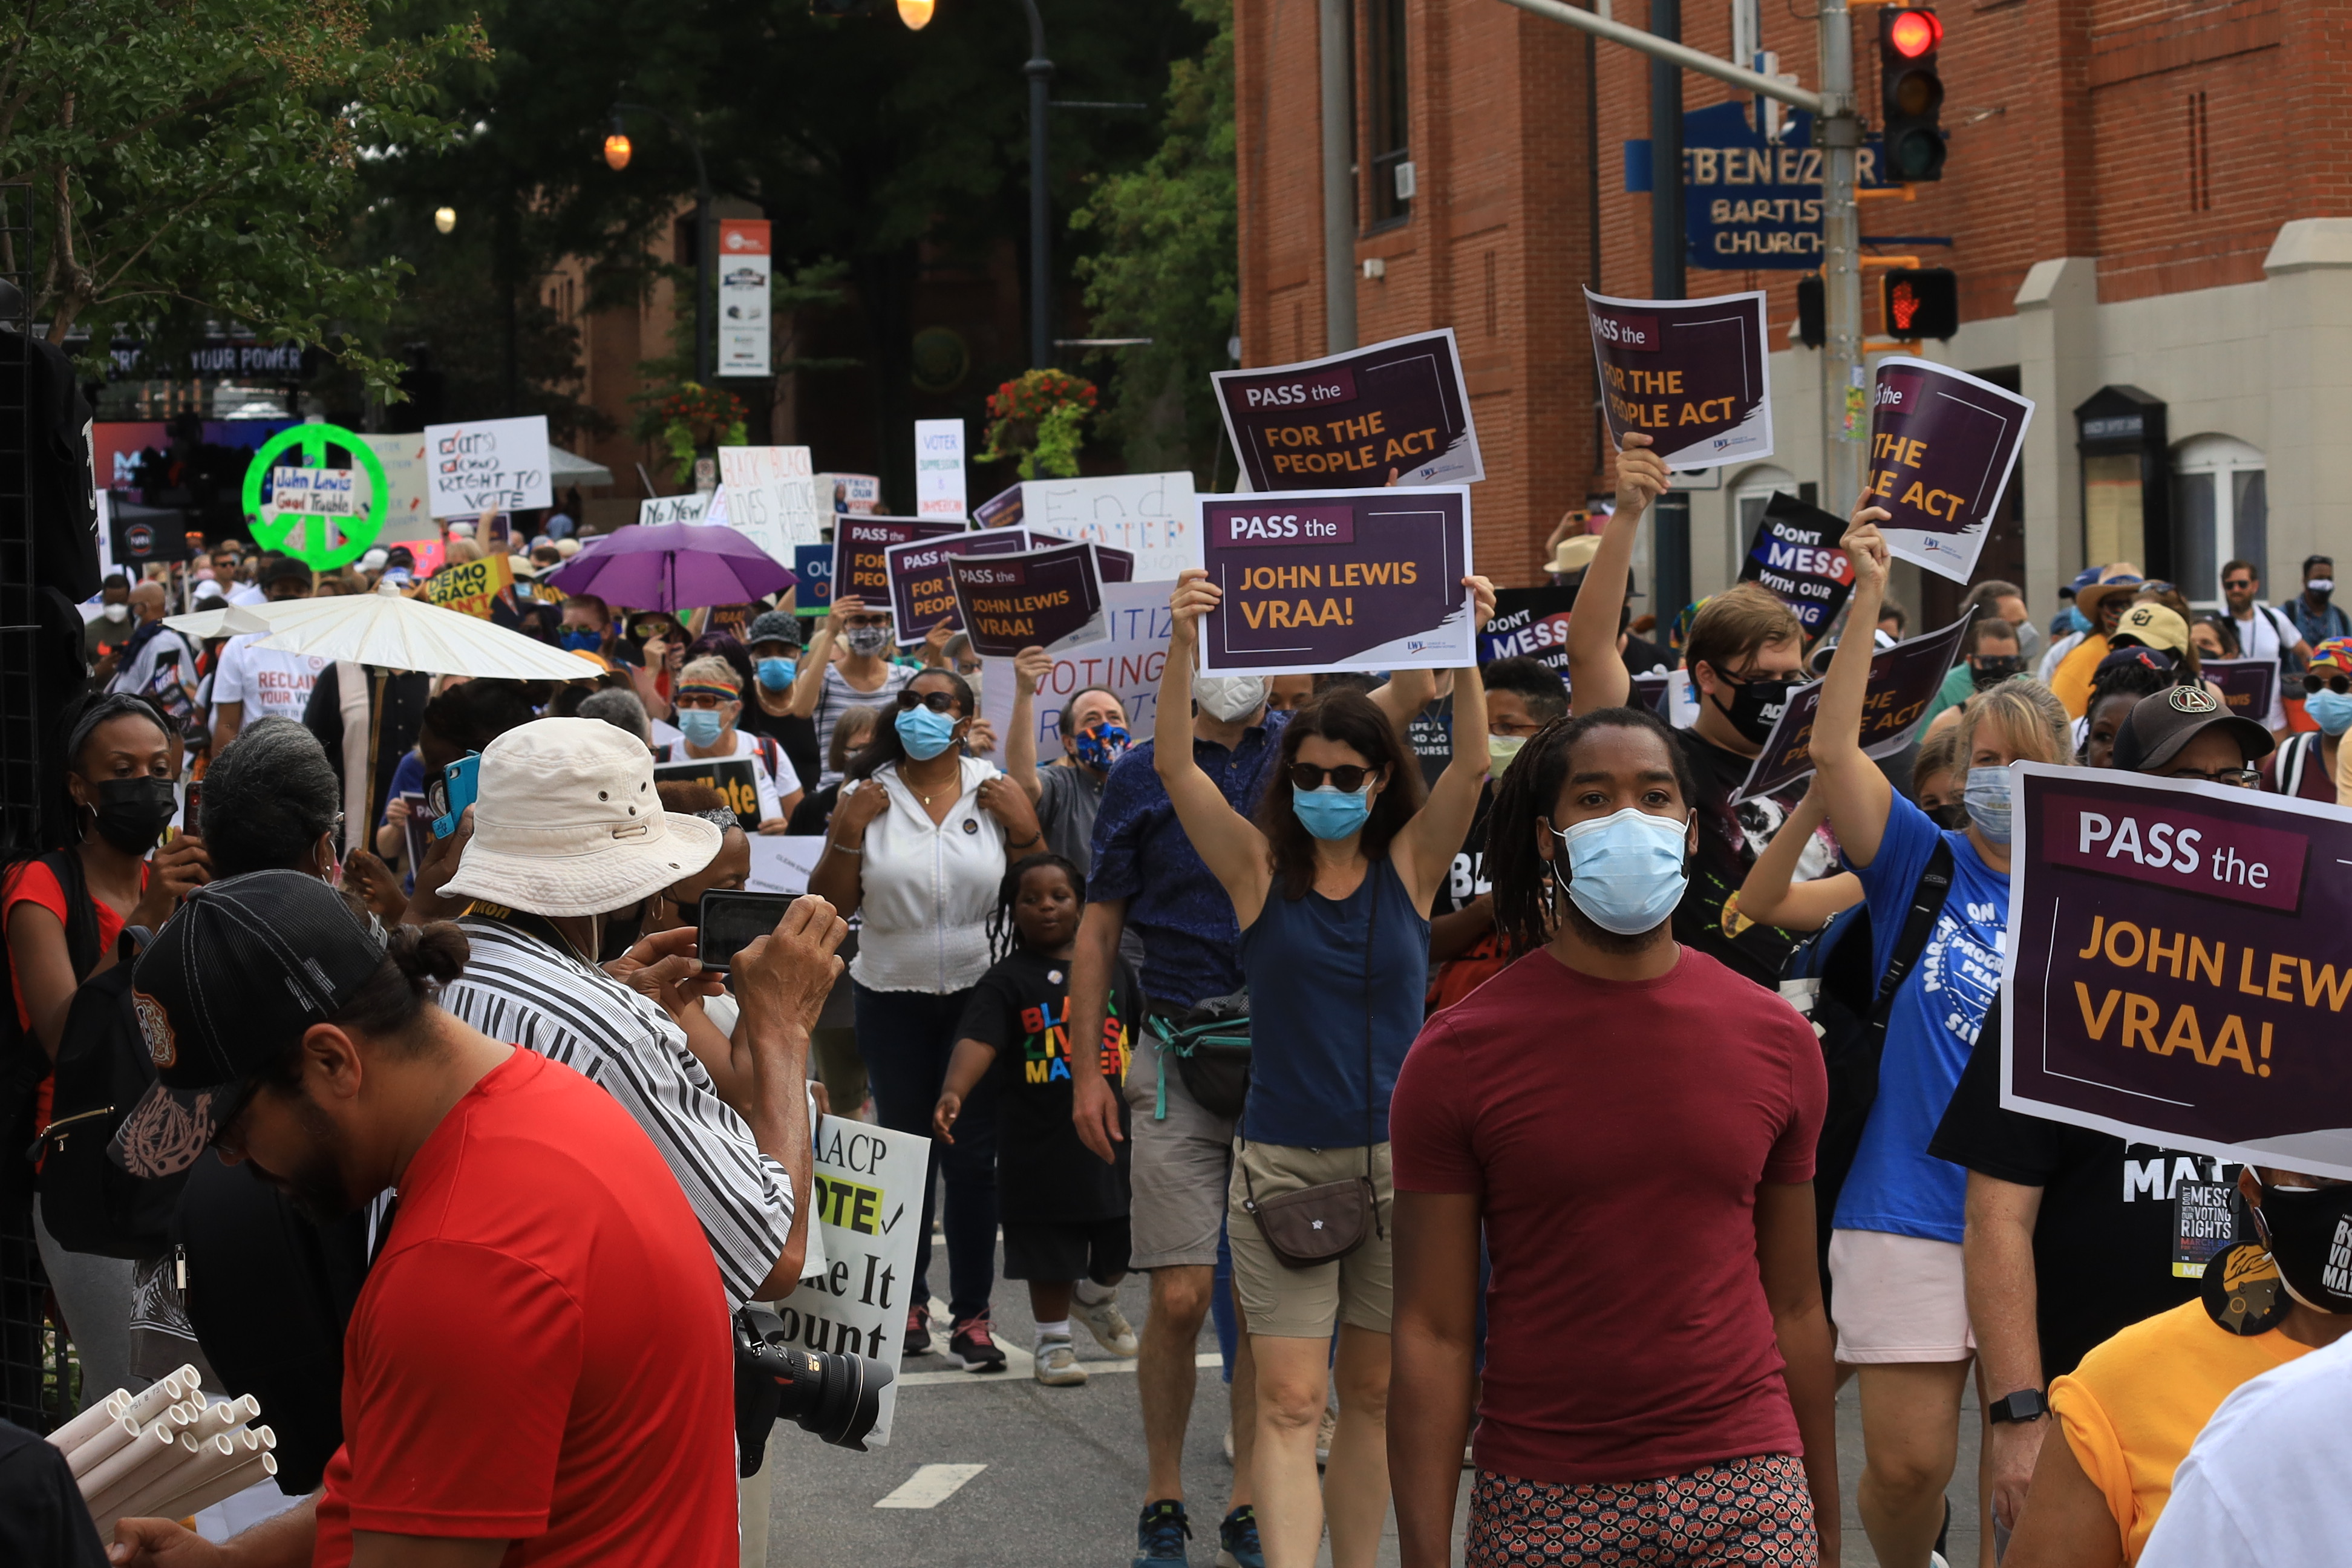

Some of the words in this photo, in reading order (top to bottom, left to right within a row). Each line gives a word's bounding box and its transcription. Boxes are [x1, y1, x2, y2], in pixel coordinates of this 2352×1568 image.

[1683, 148, 1877, 185] BENEZR
[1592, 313, 1618, 341] PASS
[1621, 326, 1645, 344] the
[241, 347, 301, 370] POWER
[1604, 361, 1626, 391] FOR
[1629, 370, 1684, 394] THE
[1246, 384, 1307, 407] PASS
[1311, 384, 1341, 400] the
[1881, 385, 1903, 405] the
[1609, 393, 1670, 427] PEOPLE
[1678, 396, 1735, 426] ACT
[1264, 425, 1323, 448] FOR
[1327, 411, 1385, 443] THE
[923, 434, 958, 451] VOTER
[1273, 445, 1377, 474] PEOPLE
[1384, 428, 1438, 462] ACT
[1875, 433, 1928, 469] THE
[276, 469, 309, 489] John
[439, 472, 505, 492] RIGHT
[514, 469, 541, 490] TO
[276, 492, 305, 509] Good
[310, 492, 349, 512] Trouble
[464, 489, 524, 509] VOTE
[1046, 475, 1172, 523] End
[1900, 481, 1965, 522] ACT
[646, 501, 664, 525] No
[852, 527, 888, 541] PASS
[889, 532, 906, 542] the
[1230, 514, 1299, 540] PASS
[1304, 518, 1337, 537] the
[1772, 523, 1822, 546] DON'T
[903, 551, 938, 570] PASS
[1768, 542, 1847, 579] MESS
[429, 563, 486, 592] DEMO
[853, 572, 889, 587] PEO
[912, 578, 944, 597] FOR
[958, 569, 994, 584] PASS
[996, 571, 1016, 583] the
[1240, 565, 1321, 590] JOHN
[1329, 561, 1417, 587] LEWIS
[1759, 569, 1795, 593] WITH
[1799, 583, 1832, 599] OUR
[443, 593, 490, 613] AN'T
[913, 595, 959, 617] PEOP
[972, 598, 1012, 613] JOHN
[1014, 590, 1070, 613] LEWIS
[1240, 597, 1354, 629] VRAA!
[976, 617, 1035, 636] VRAA!
[1487, 609, 1531, 633] DON'T
[1492, 619, 1569, 659] MESS
[260, 690, 290, 705] YOUR
[1864, 690, 1897, 708] HE
[1875, 699, 1925, 731] ACT
[416, 805, 436, 818] PA
[2079, 811, 2203, 875] PASS
[2211, 846, 2270, 889] the
[471, 900, 512, 920] ikon
[1967, 902, 1996, 922] ON
[1923, 915, 1959, 993] MARCH
[1950, 937, 2005, 973] PROGR
[2078, 915, 2226, 987] JOHN
[2238, 947, 2352, 1013] LEW
[1962, 959, 2001, 992] PEAC
[1024, 1017, 1120, 1058] LIVS
[2074, 981, 2273, 1079] VRAA!
[815, 1129, 887, 1175] ACP
[815, 1177, 877, 1235] OTE
[2190, 1186, 2232, 1207] MESS
[2181, 1212, 2194, 1220] OUR
[2194, 1206, 2232, 1222] VOTING
[2181, 1219, 2232, 1240] RIGHTS
[2181, 1237, 2214, 1246] MARCH
[858, 1253, 896, 1310] It
[780, 1307, 887, 1360] ount
